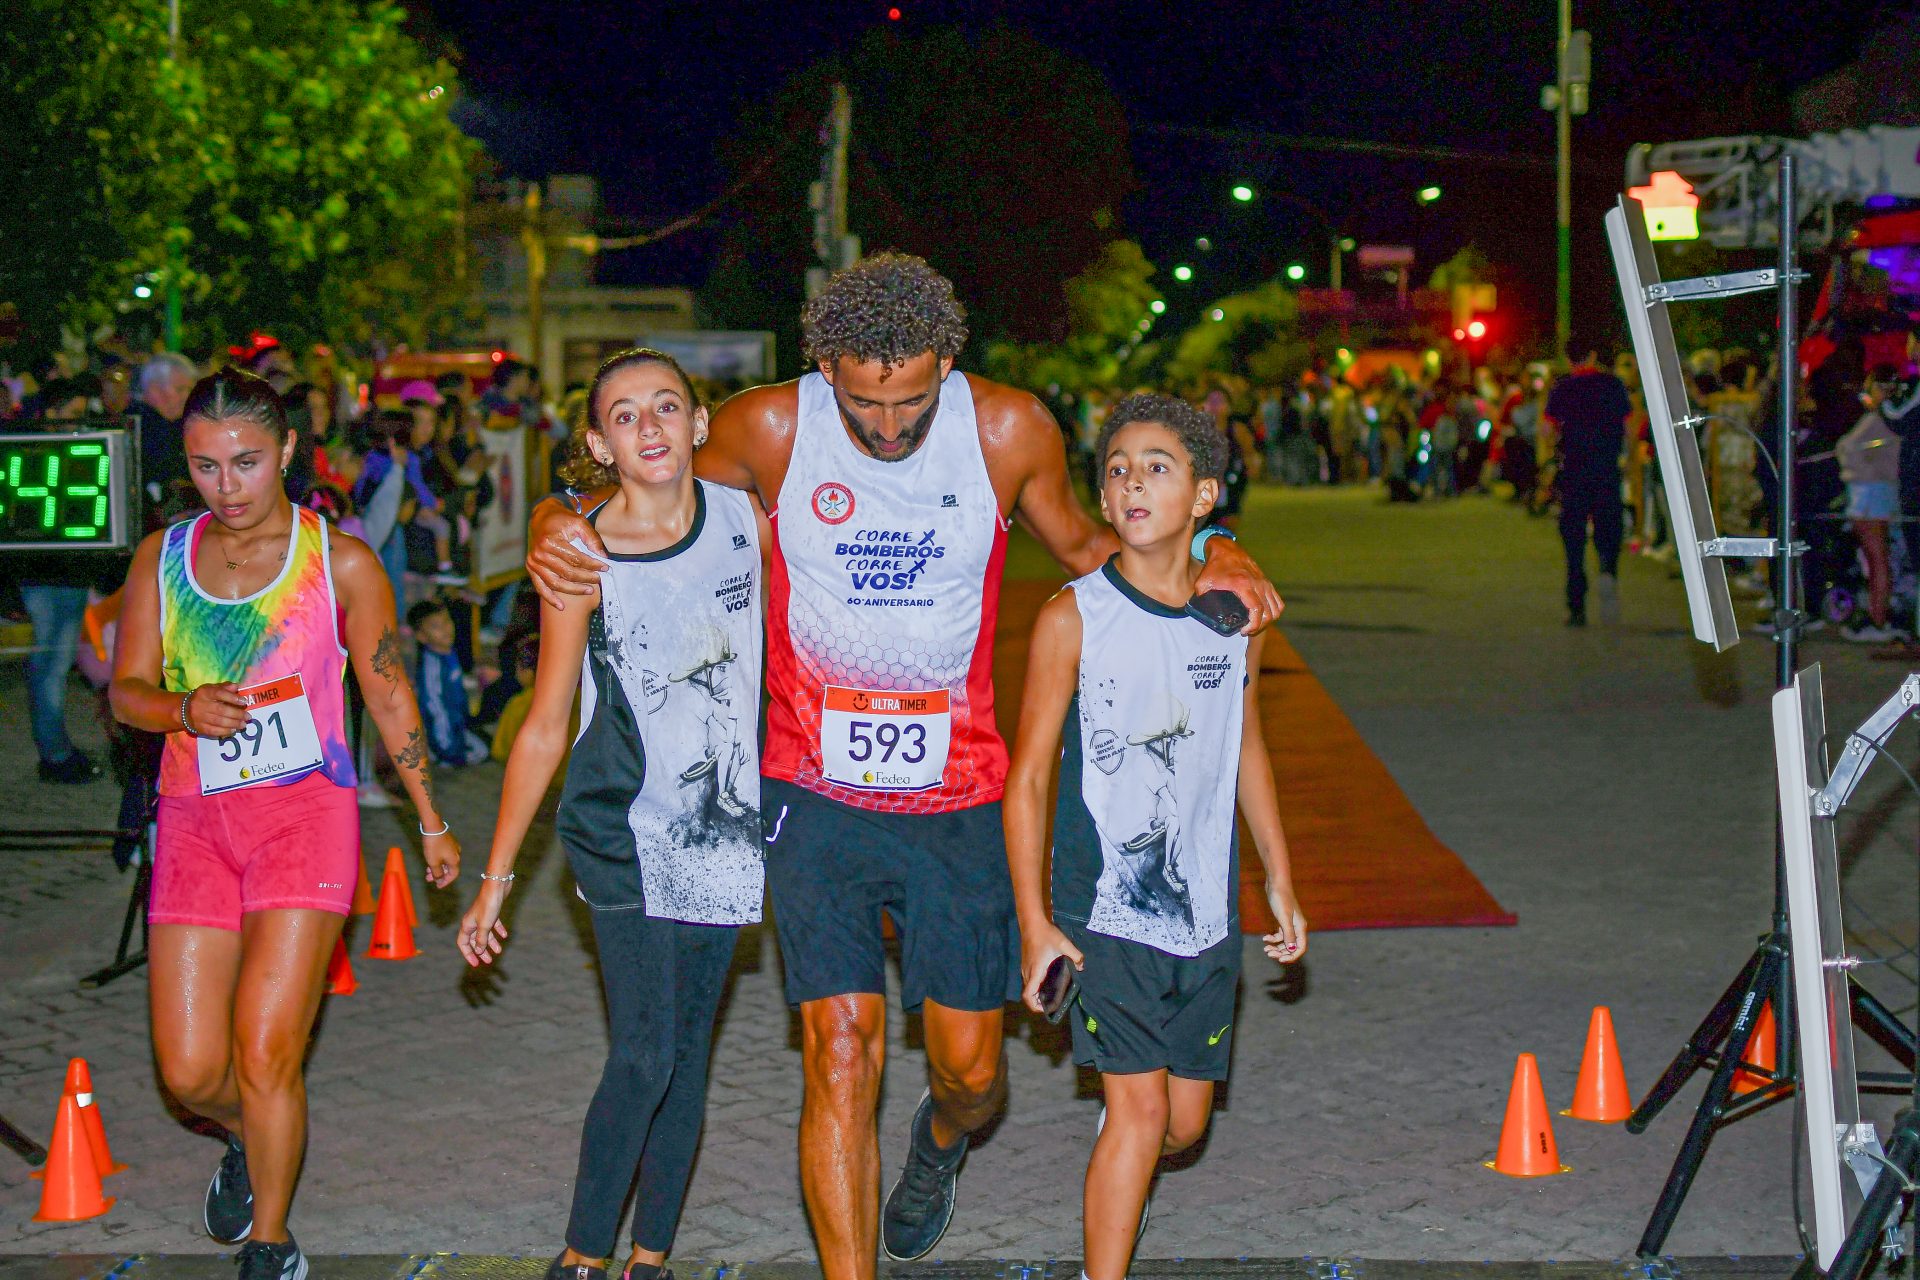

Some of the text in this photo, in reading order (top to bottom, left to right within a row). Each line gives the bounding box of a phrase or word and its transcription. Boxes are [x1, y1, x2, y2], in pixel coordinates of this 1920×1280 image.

[855, 528, 936, 546] CORRE X
[835, 543, 946, 558] BOMBEROS
[846, 558, 927, 574] CORRE X
[720, 575, 743, 587] CORRE
[851, 573, 917, 590] VOS!
[715, 581, 752, 598] BOMBERO
[722, 591, 745, 604] CORRE
[1221, 654, 1228, 664] X
[1187, 663, 1231, 671] BOMBEROS
[1218, 670, 1226, 679] X
[1194, 679, 1222, 689] VOS!
[871, 698, 927, 710] ULTRATIMER
[219, 711, 288, 762] 591
[848, 721, 927, 763] 593
[250, 762, 285, 776] Fedea
[876, 771, 911, 784] Fedea
[1734, 991, 1756, 1031] gemini
